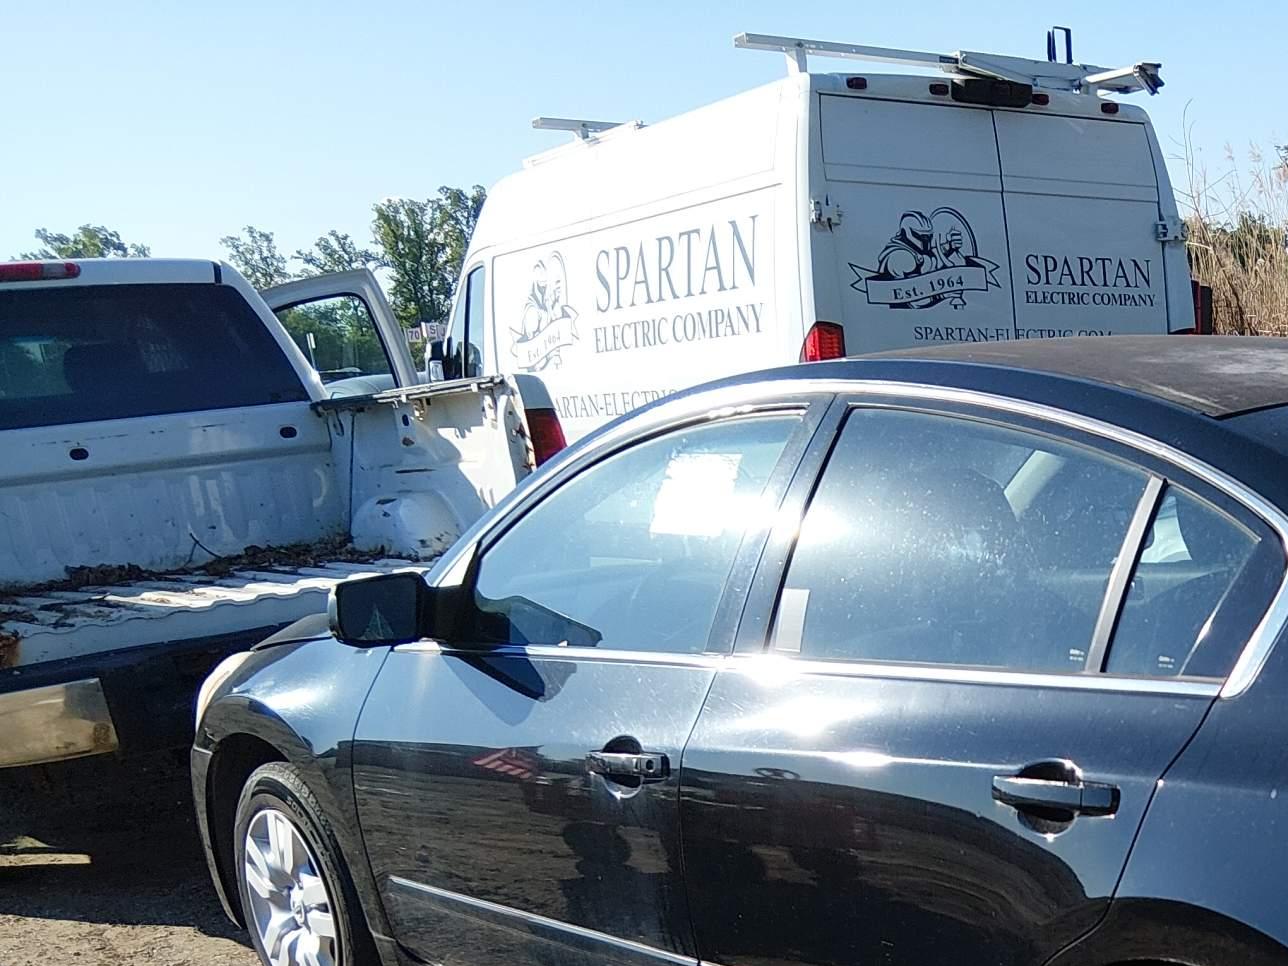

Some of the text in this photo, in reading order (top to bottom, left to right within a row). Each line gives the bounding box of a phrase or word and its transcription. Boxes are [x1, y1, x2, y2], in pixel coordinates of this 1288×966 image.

[595, 215, 759, 313] SPARTAN
[1025, 254, 1151, 288] SPARTAN
[893, 275, 964, 300] Est. 1964
[1025, 291, 1155, 307] ELECTRIC COMPANY
[594, 303, 764, 354] ELECTRIC COMPANY
